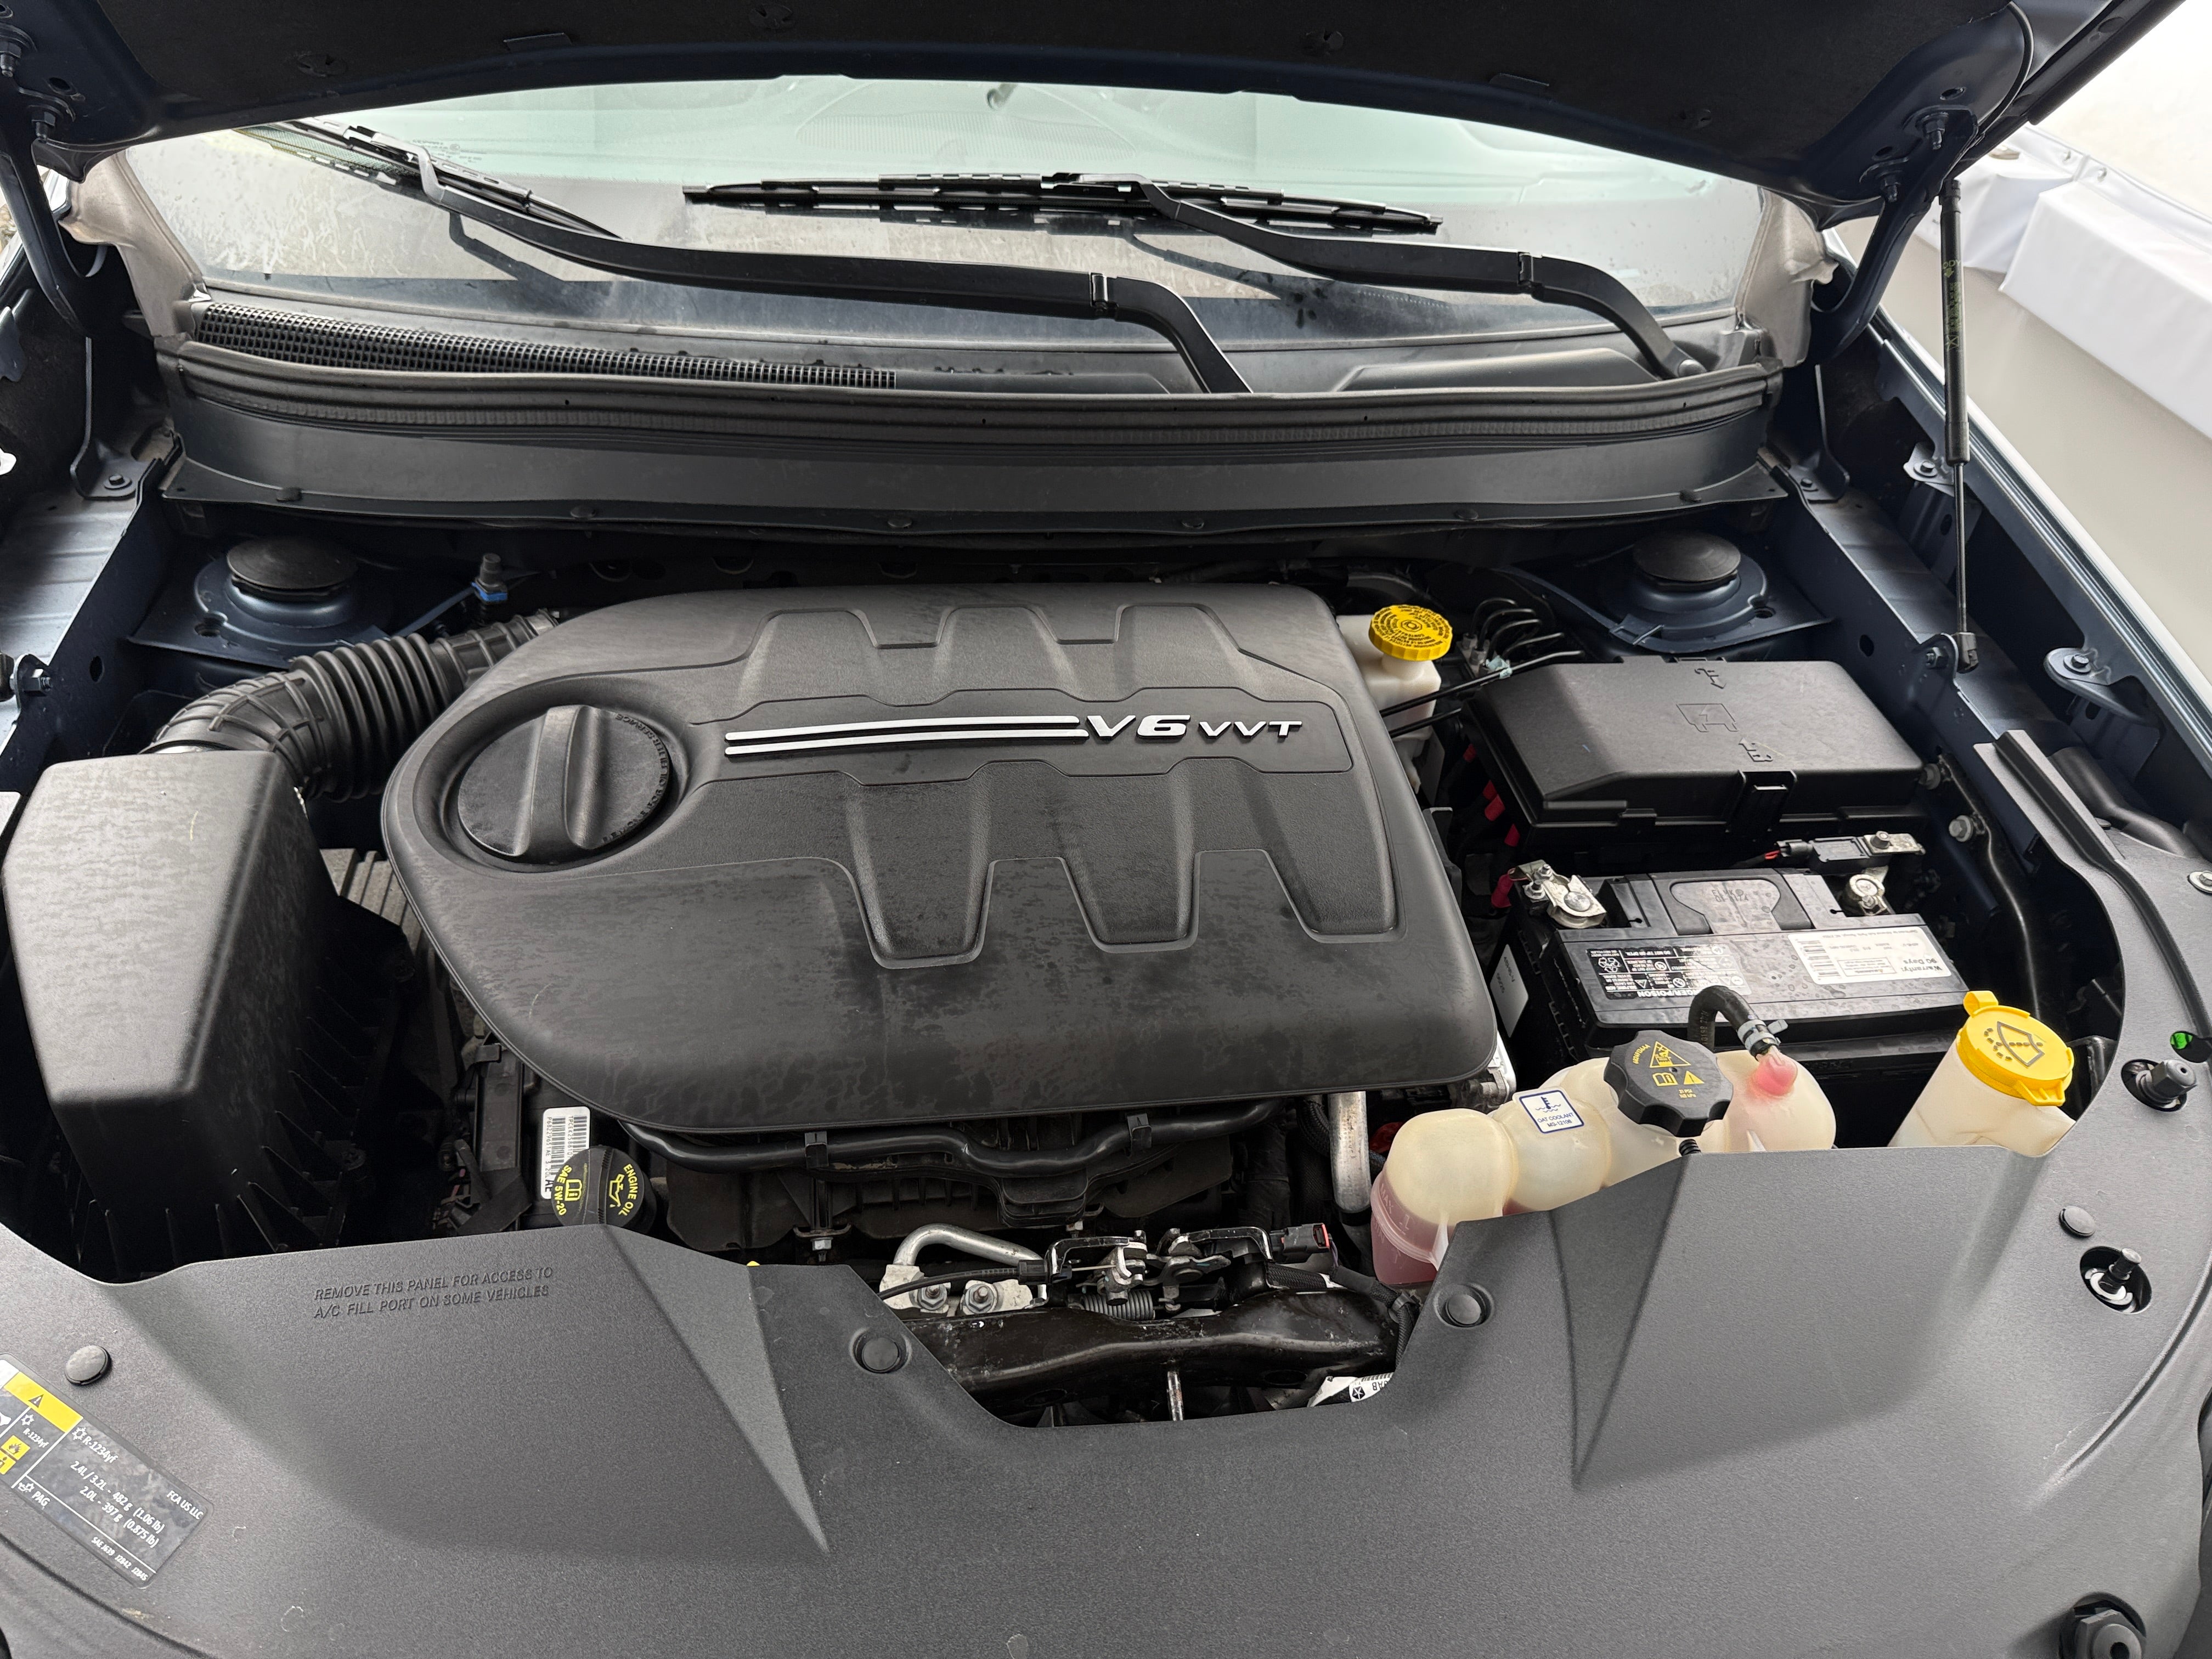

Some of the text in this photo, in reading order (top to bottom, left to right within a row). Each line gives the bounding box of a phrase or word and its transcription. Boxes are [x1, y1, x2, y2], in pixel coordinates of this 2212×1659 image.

[615, 713, 656, 740] SERVICE
[1085, 714, 1303, 741] V6 VVT
[1548, 1111, 1574, 1121] COOLANT
[554, 1164, 572, 1216] SAE 5W-20
[618, 1163, 638, 1216] ENGINE OIL
[315, 1266, 554, 1301] REMOVE THIS PANEL FOR ACCESS TO
[314, 1285, 550, 1319] A/C FILL PORT ON SOME VEHICLES
[23, 1427, 49, 1448] R-1234yf
[82, 1436, 119, 1463] R-1234yf
[32, 1491, 51, 1508] PAG
[166, 1490, 204, 1520] FCA US LLC
[80, 1486, 98, 1502] 2.0L
[123, 1518, 149, 1540] (0.875
[145, 1534, 160, 1548] lb)
[133, 1507, 155, 1525] (1.06
[151, 1520, 165, 1534] lb)
[91, 1537, 104, 1547] SAE
